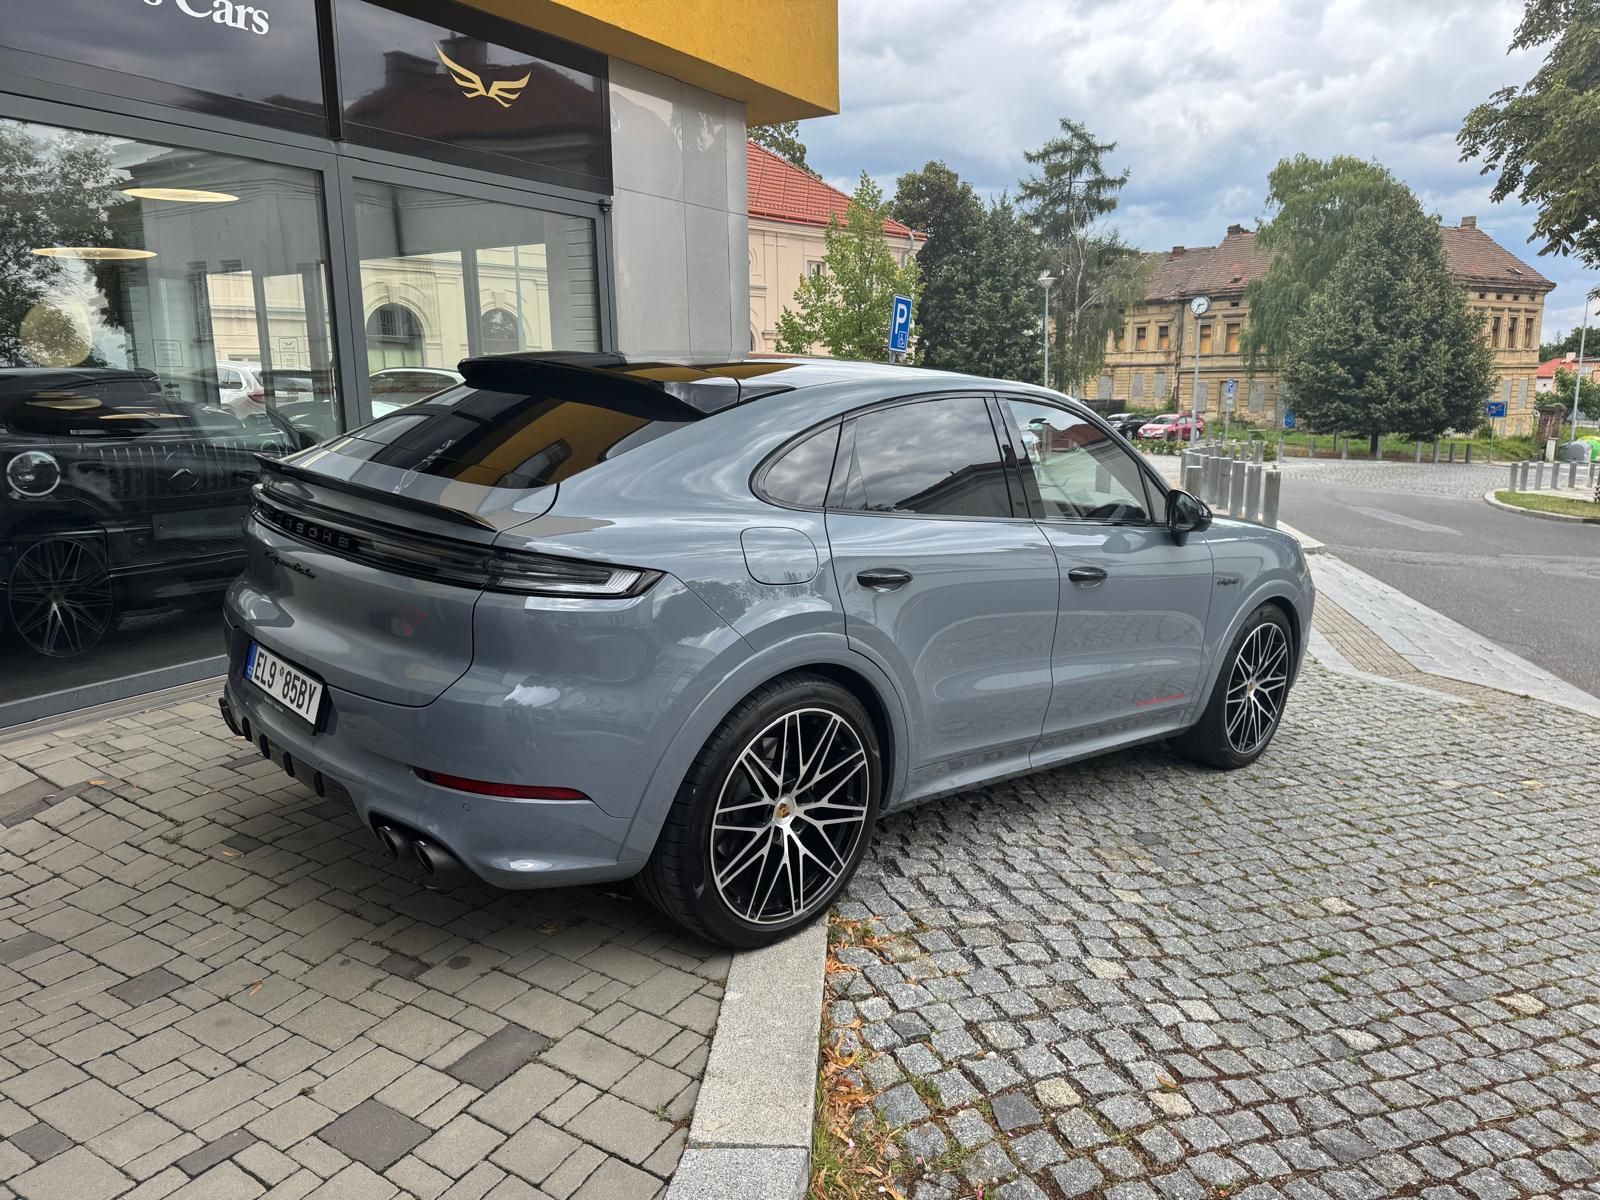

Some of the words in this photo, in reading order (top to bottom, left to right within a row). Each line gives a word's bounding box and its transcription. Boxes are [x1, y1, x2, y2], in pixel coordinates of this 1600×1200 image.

[895, 303, 907, 334] P
[263, 509, 350, 548] ORSCHE
[254, 652, 277, 689] EL9
[282, 670, 317, 715] 85BY
